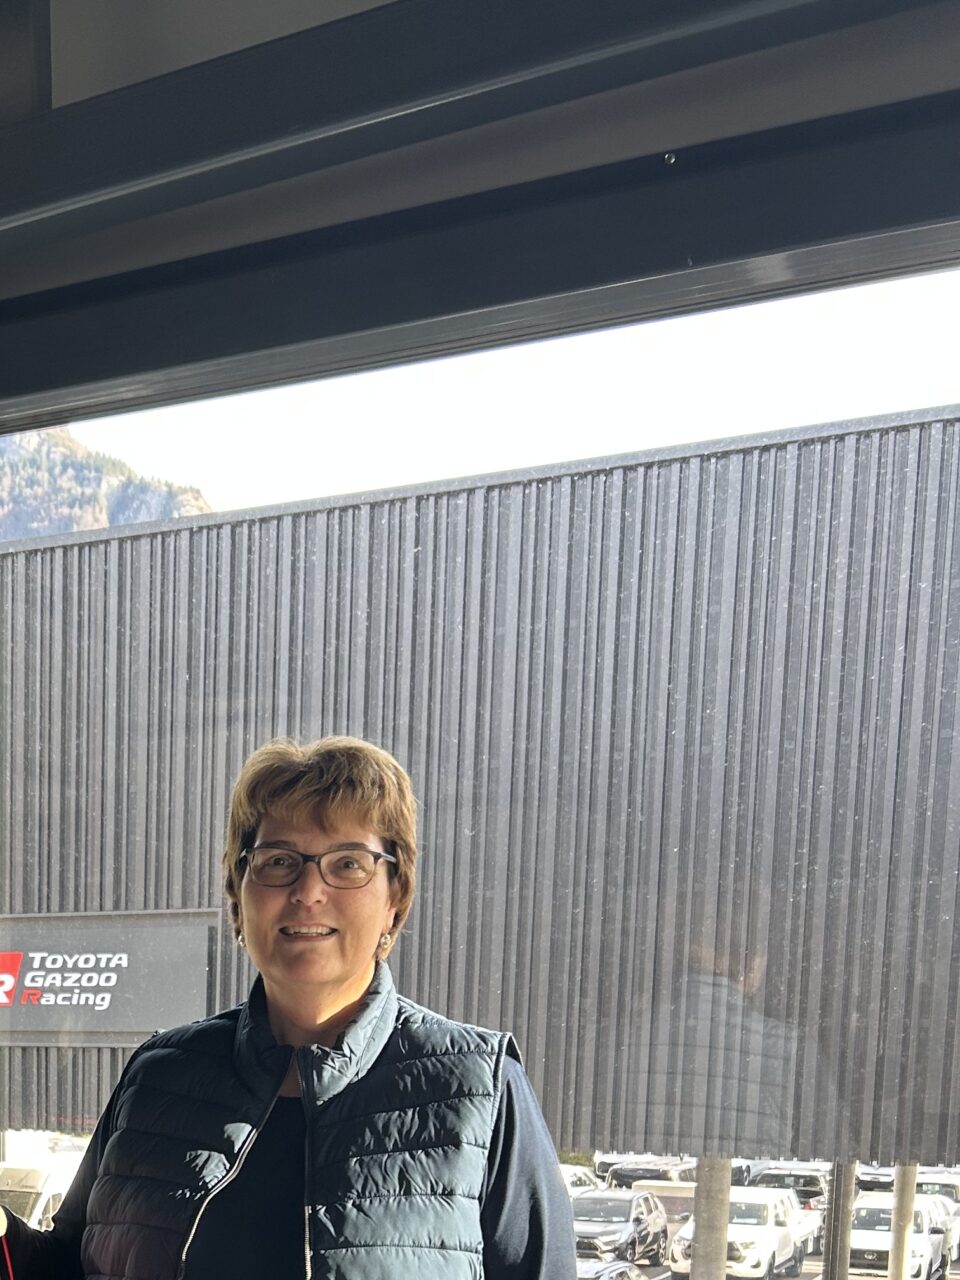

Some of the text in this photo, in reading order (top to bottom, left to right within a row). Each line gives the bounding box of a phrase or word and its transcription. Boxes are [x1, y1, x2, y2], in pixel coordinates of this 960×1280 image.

[28, 952, 129, 969] TOYOTA
[24, 971, 117, 988] GAZOO
[20, 989, 111, 1010] Racing
